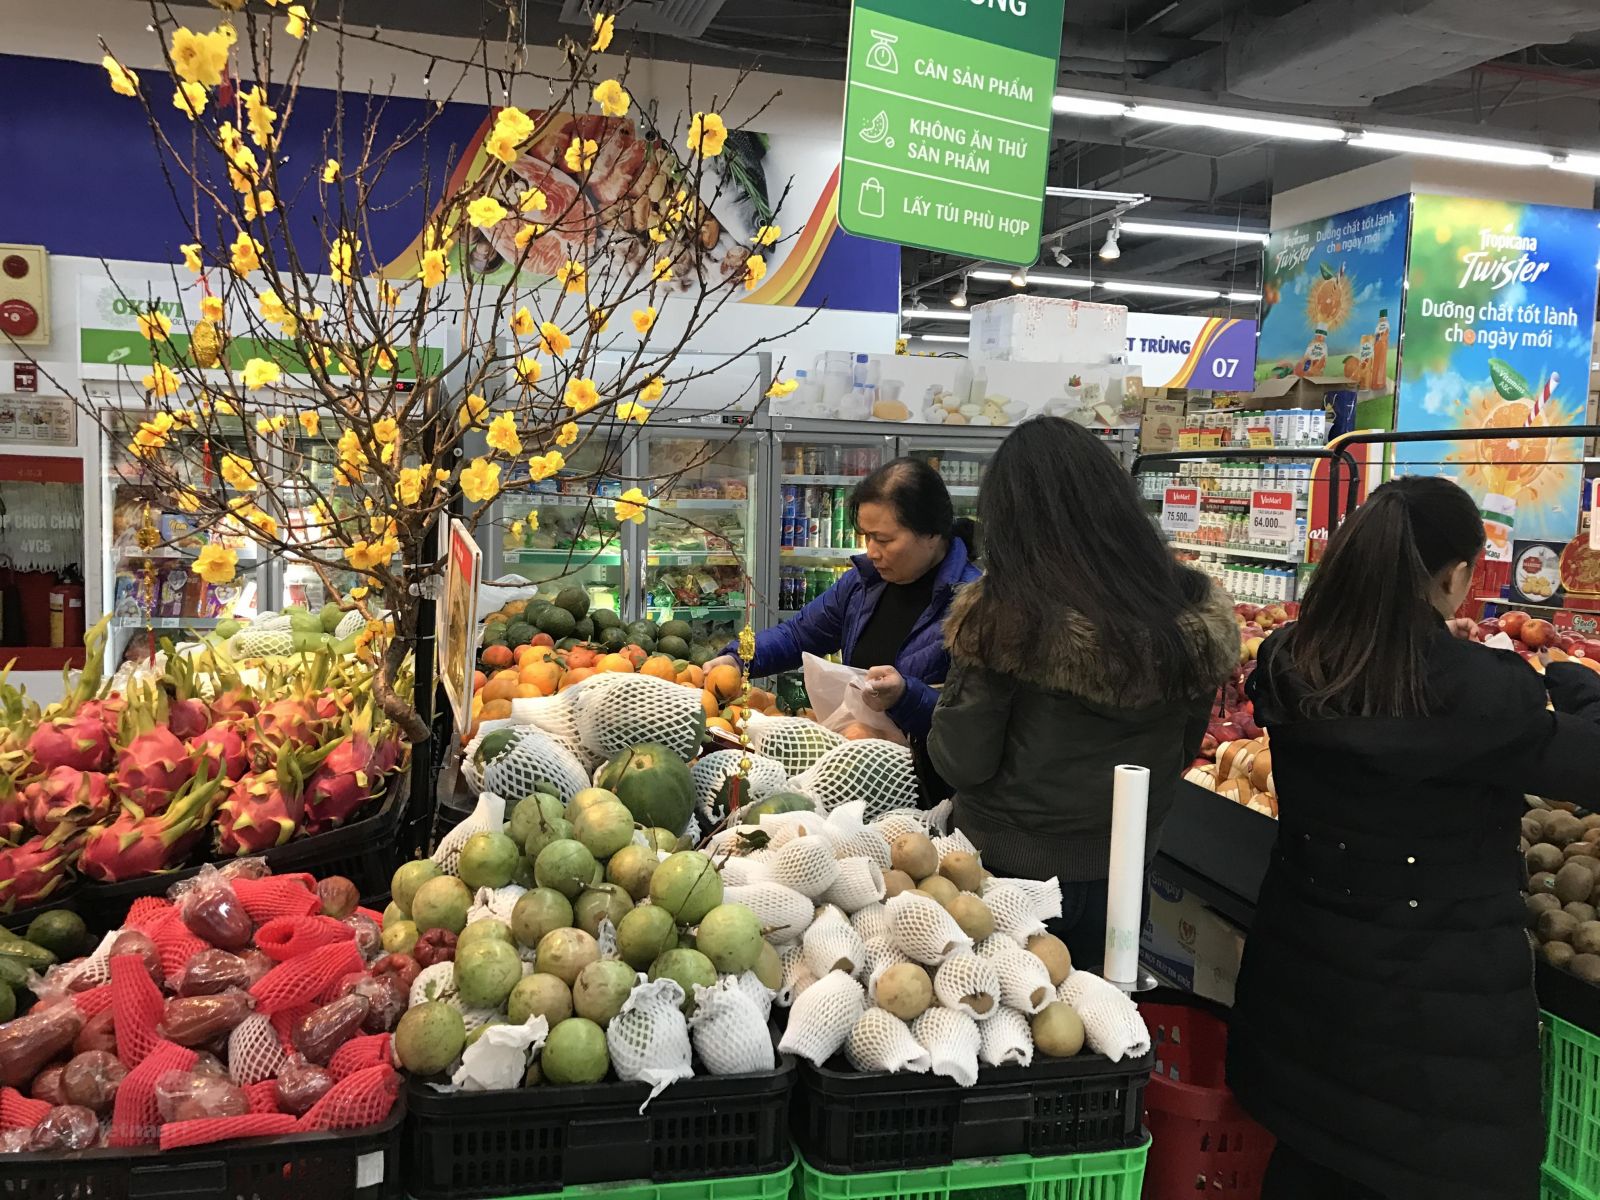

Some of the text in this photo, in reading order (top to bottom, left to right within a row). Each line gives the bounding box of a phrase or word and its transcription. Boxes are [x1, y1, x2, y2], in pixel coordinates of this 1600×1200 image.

[914, 59, 1033, 102] CÂN SẢN PHẨM
[910, 118, 1028, 159] KHÔNG ĂN THỬ
[908, 140, 990, 174] SẢN PHẨM
[903, 195, 1030, 237] LẤY TÚI PHÙ HỢP
[1283, 230, 1310, 249] Tropicana
[1479, 224, 1538, 251] Tropicana
[1275, 245, 1315, 275] Twister
[1458, 251, 1549, 290] Twister
[114, 299, 185, 318] OKWI
[1421, 298, 1578, 327] Dưỡng chất tốt lành
[1478, 327, 1517, 350] ngày
[1522, 328, 1552, 348] mới
[1212, 358, 1239, 378] 07
[1260, 495, 1282, 505] VinMart
[1168, 511, 1188, 522] 75.500
[1254, 516, 1279, 529] 64.000
